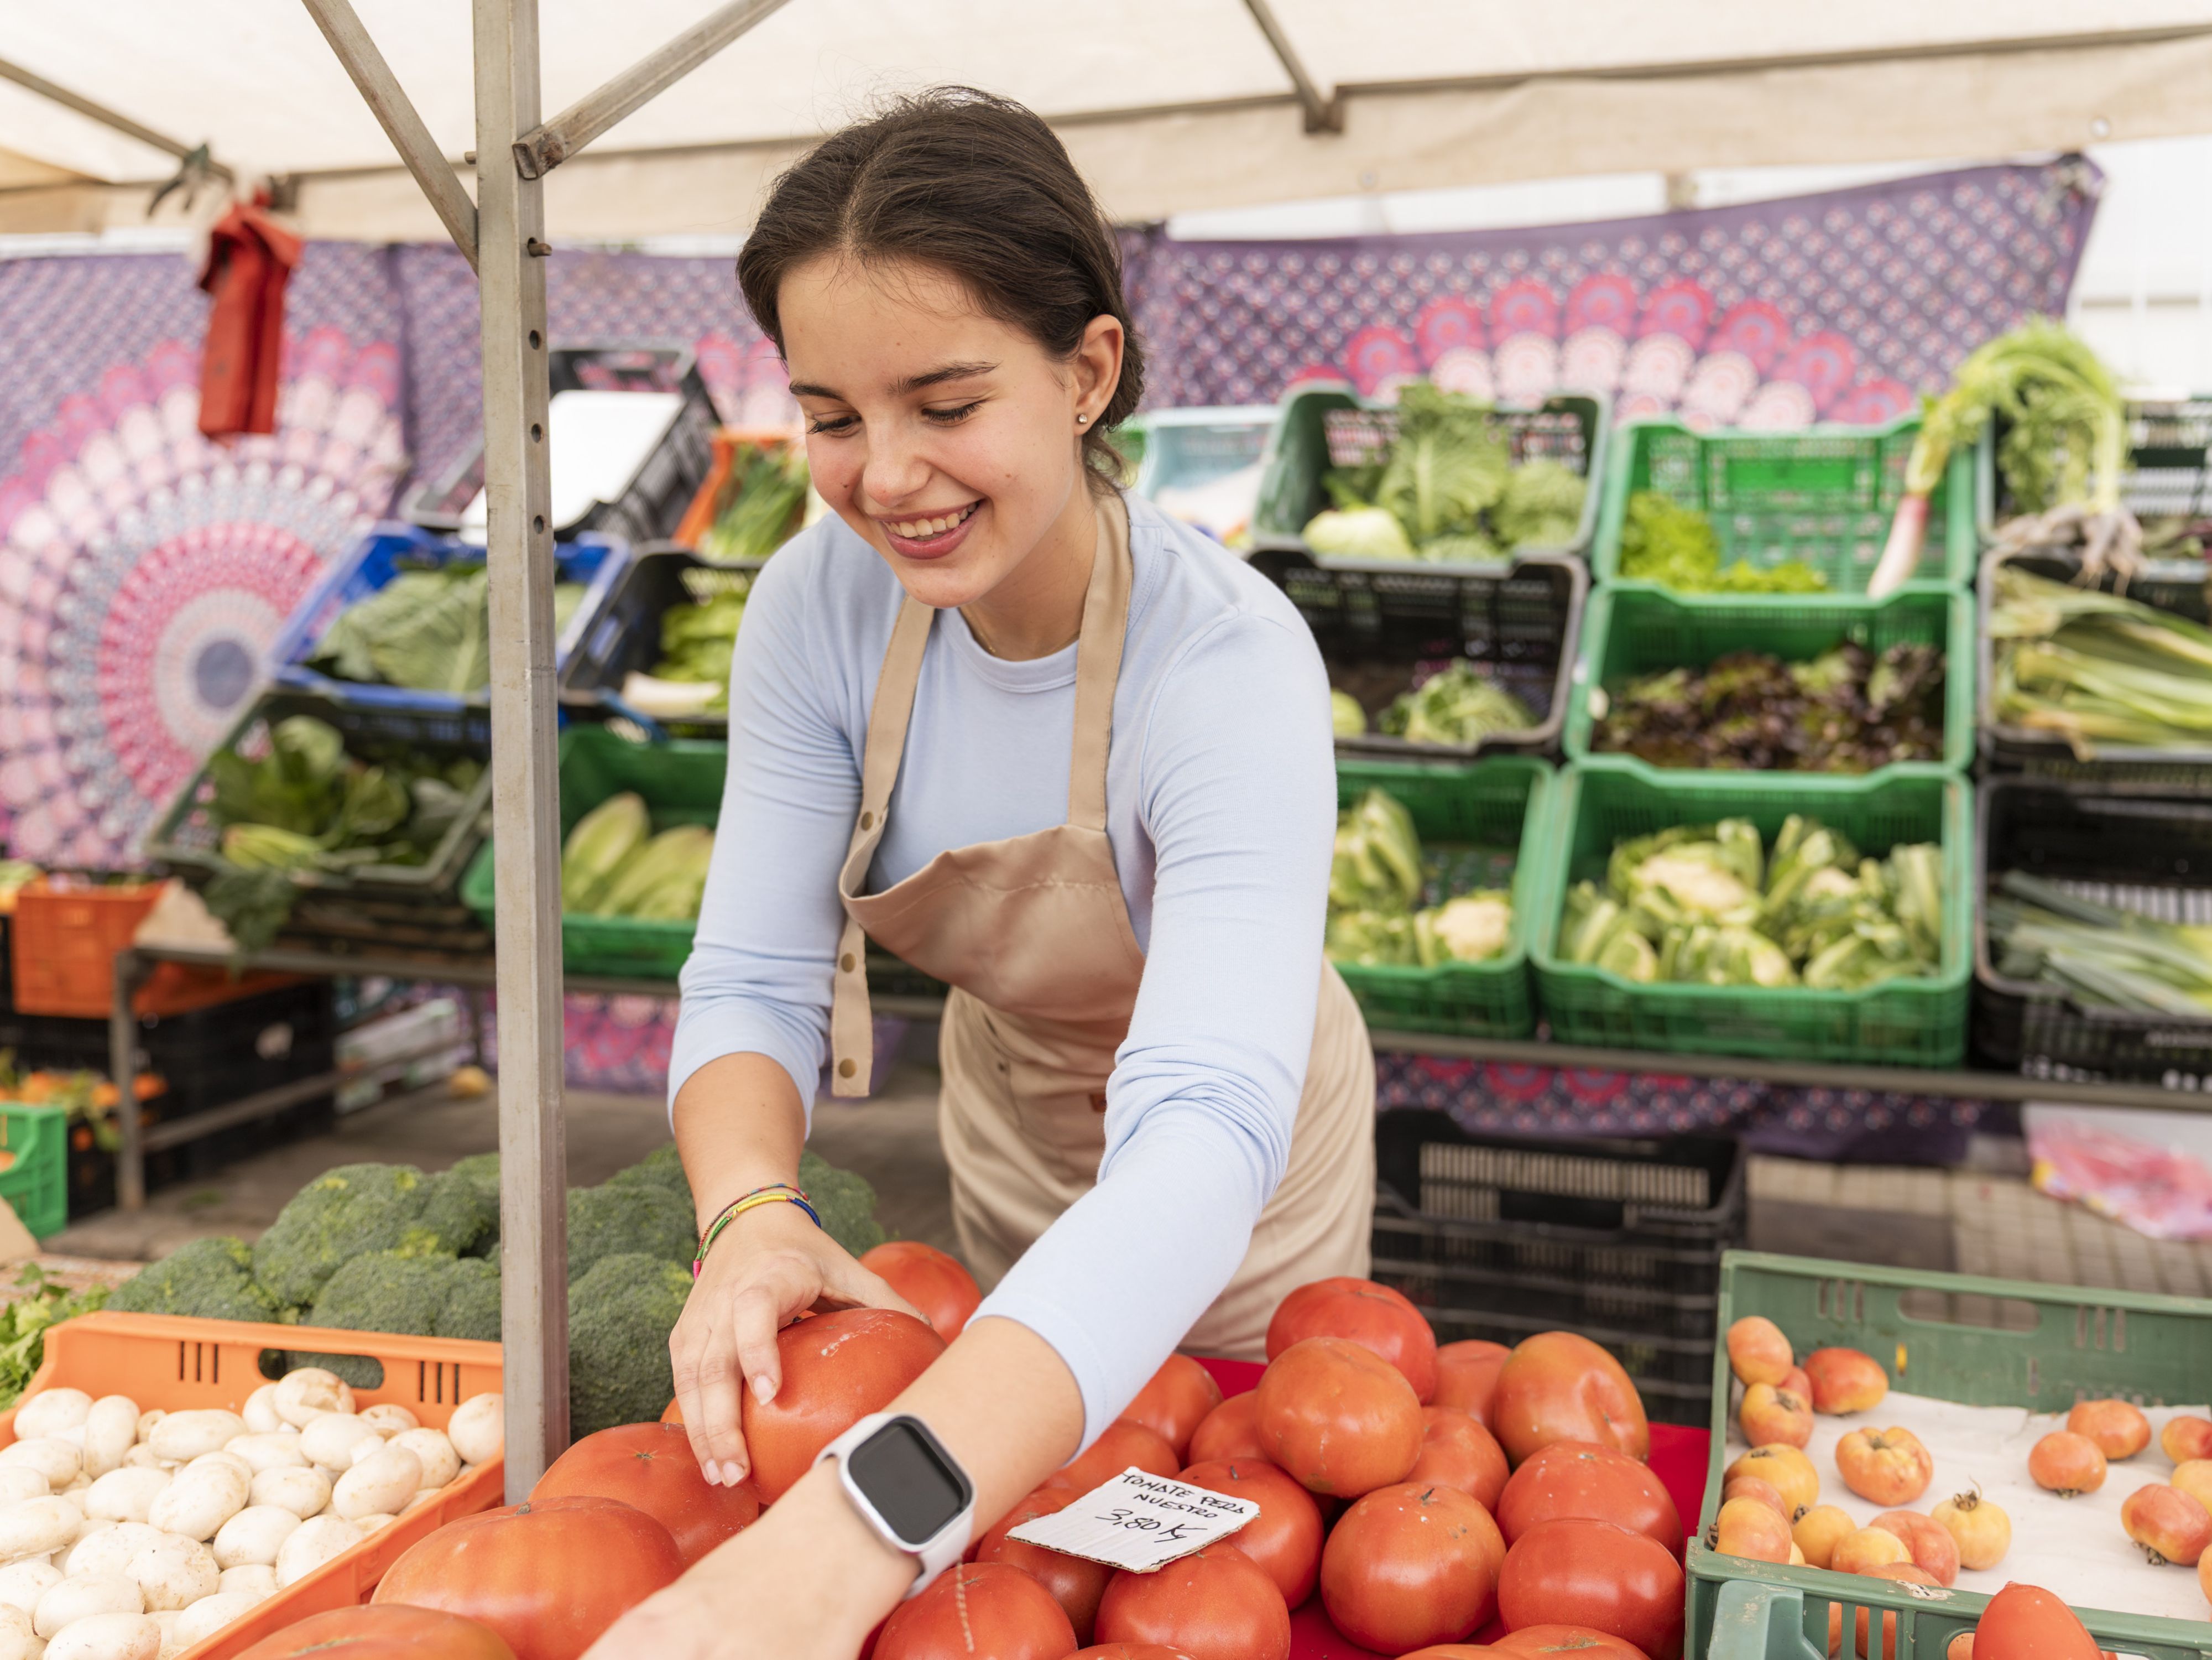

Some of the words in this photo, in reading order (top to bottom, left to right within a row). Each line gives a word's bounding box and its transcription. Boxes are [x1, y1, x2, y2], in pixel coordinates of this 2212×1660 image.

[1122, 1473, 1195, 1497] TOMATE
[1199, 1496, 1244, 1513] PERA
[1133, 1494, 1218, 1518] NUESTRO
[1094, 1508, 1161, 1530] 3,80
